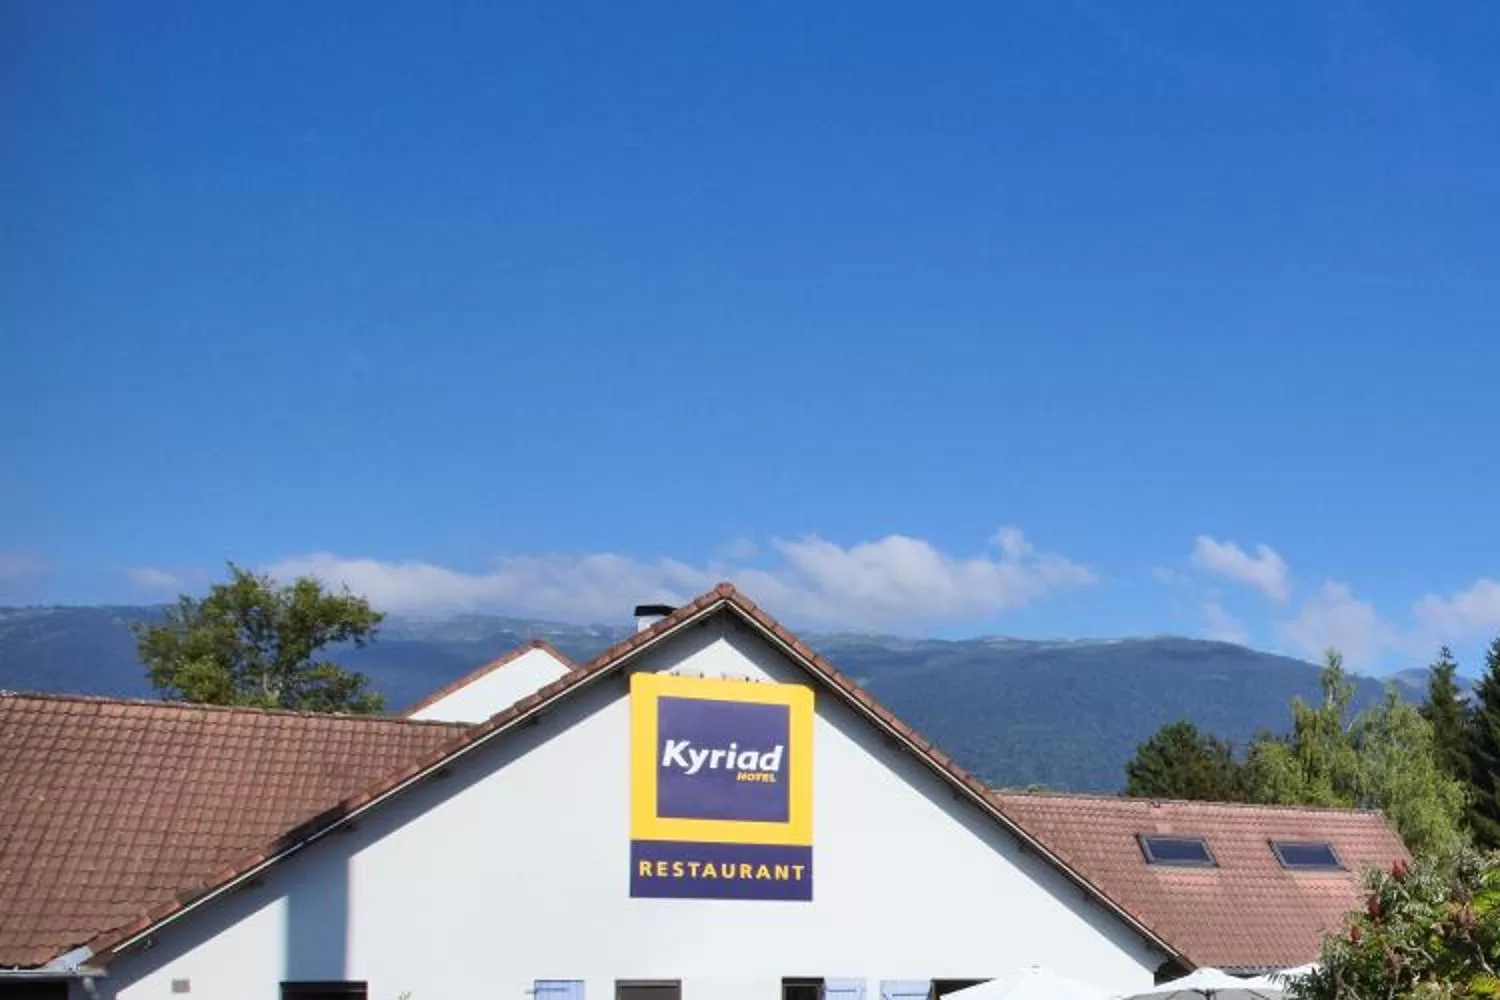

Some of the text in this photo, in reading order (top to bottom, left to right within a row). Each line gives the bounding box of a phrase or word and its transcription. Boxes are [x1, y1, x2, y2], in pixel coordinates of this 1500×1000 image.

[661, 738, 784, 775] Kyriad
[736, 771, 777, 783] HOTEL
[638, 860, 805, 881] RESTAURANT
